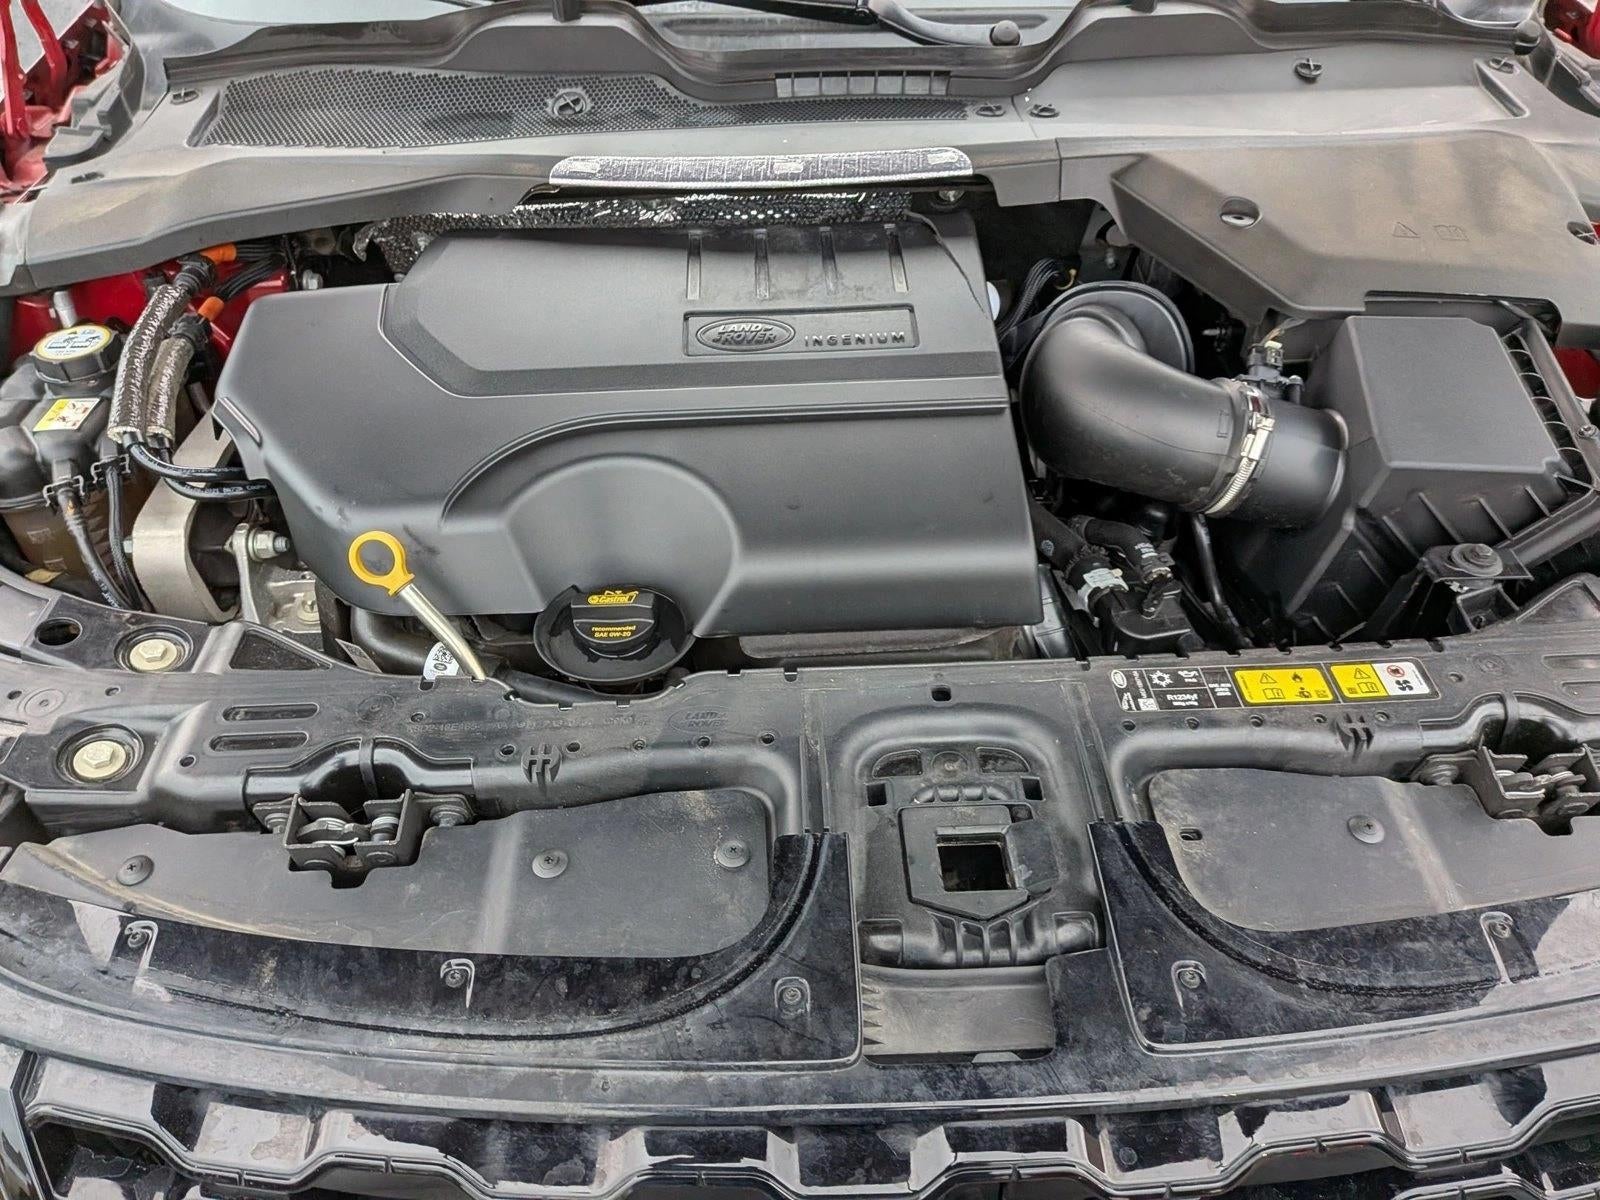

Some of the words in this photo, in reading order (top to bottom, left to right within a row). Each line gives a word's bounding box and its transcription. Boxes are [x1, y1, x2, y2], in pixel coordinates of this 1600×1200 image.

[716, 333, 777, 345] ROVER
[804, 331, 906, 347] INGENIUM
[599, 595, 630, 603] Castrol
[1166, 693, 1199, 701] R1234yf
